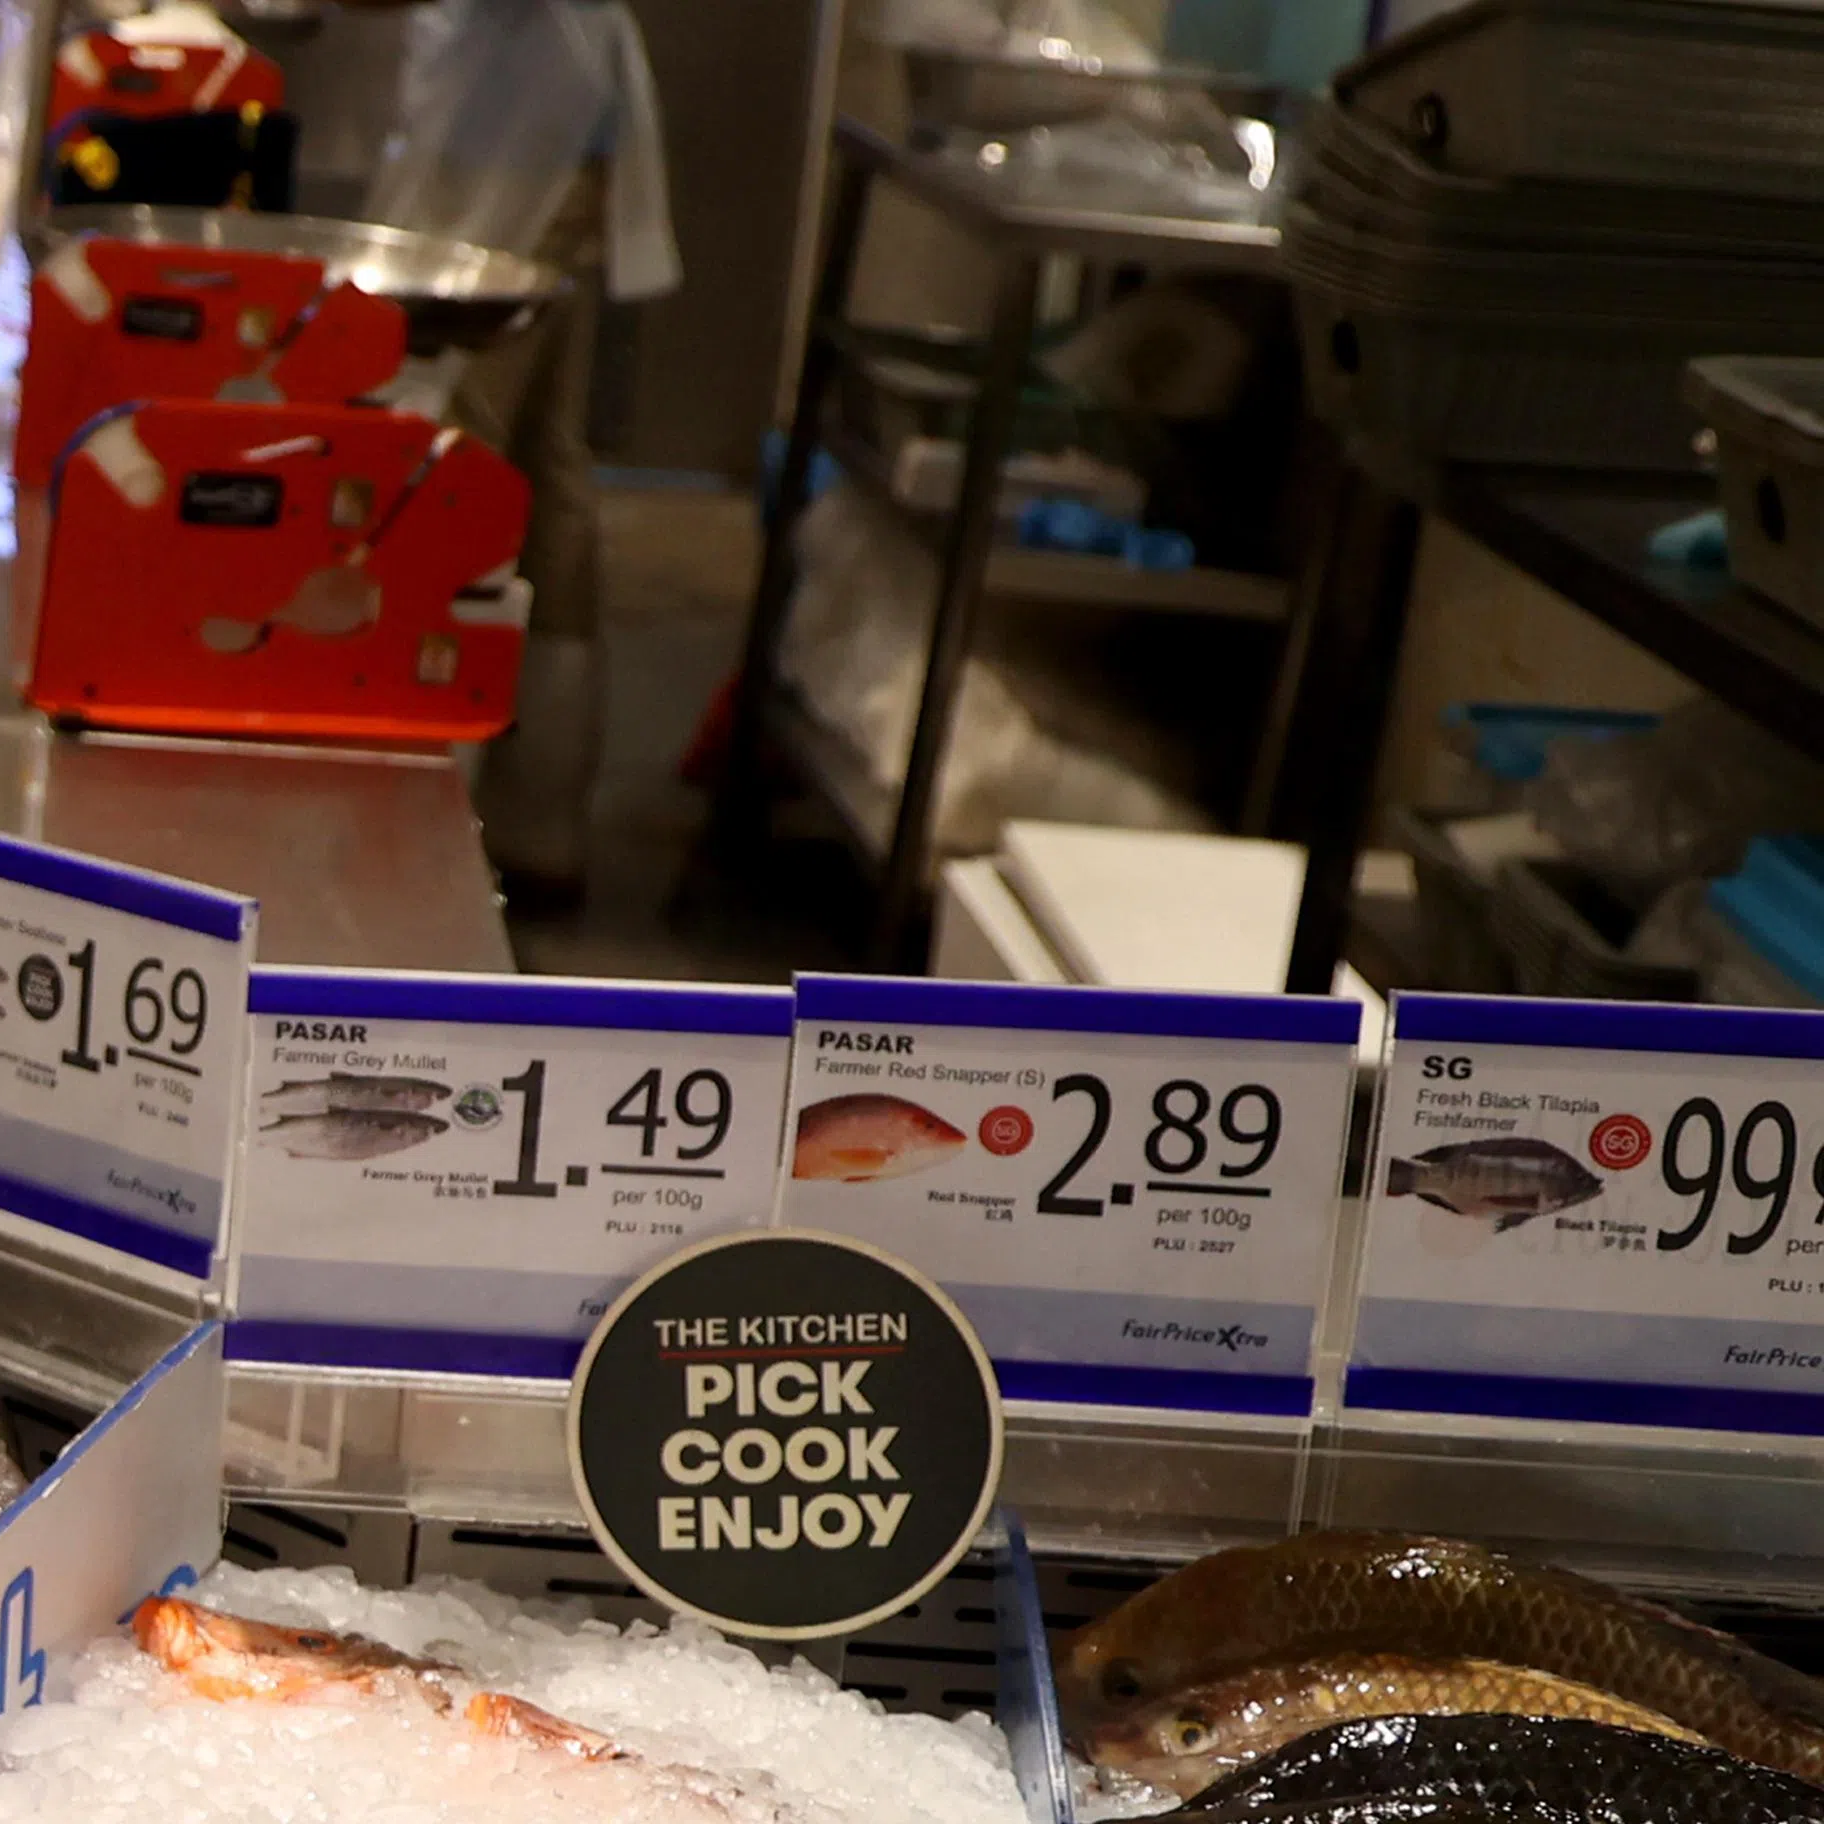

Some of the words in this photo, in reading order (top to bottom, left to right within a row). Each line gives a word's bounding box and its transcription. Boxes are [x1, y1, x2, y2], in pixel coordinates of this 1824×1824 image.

[62, 938, 209, 1073] 1.69
[275, 1021, 368, 1043] PASAR
[818, 1030, 915, 1054] PASAR
[272, 1047, 337, 1066] Farmer
[344, 1051, 386, 1070] Grey
[393, 1053, 447, 1071] Mullet
[1422, 1054, 1472, 1080] SG
[814, 1057, 881, 1077] Farmer
[888, 1061, 927, 1080] Red
[932, 1064, 1011, 1086] Snapper
[1016, 1068, 1046, 1088] (S)
[135, 1072, 156, 1088] per
[162, 1077, 194, 1105] 100g
[1416, 1087, 1471, 1109] Fresh
[1478, 1091, 1530, 1111] Black
[1538, 1094, 1600, 1116] Tilapia
[492, 1059, 733, 1198] 1.49
[1414, 1109, 1517, 1132] Fishfarmer
[1036, 1073, 1283, 1216] 2.89
[613, 1190, 647, 1207] per
[655, 1188, 703, 1211] 100g
[605, 1219, 637, 1233] PLU
[1157, 1208, 1192, 1225] per
[1200, 1207, 1252, 1231] 100g
[1555, 1217, 1594, 1231] Black
[1599, 1219, 1647, 1235] Tilapia
[1153, 1237, 1186, 1251] PLU
[1786, 1238, 1824, 1256] per
[1768, 1277, 1803, 1293] PLU
[654, 1318, 728, 1348] THE
[739, 1313, 908, 1347] KITCHEN
[1724, 1344, 1824, 1371] FairPrice
[684, 1360, 875, 1418] PICK
[660, 1426, 901, 1486] COOK
[658, 1492, 912, 1551] ENJOY
